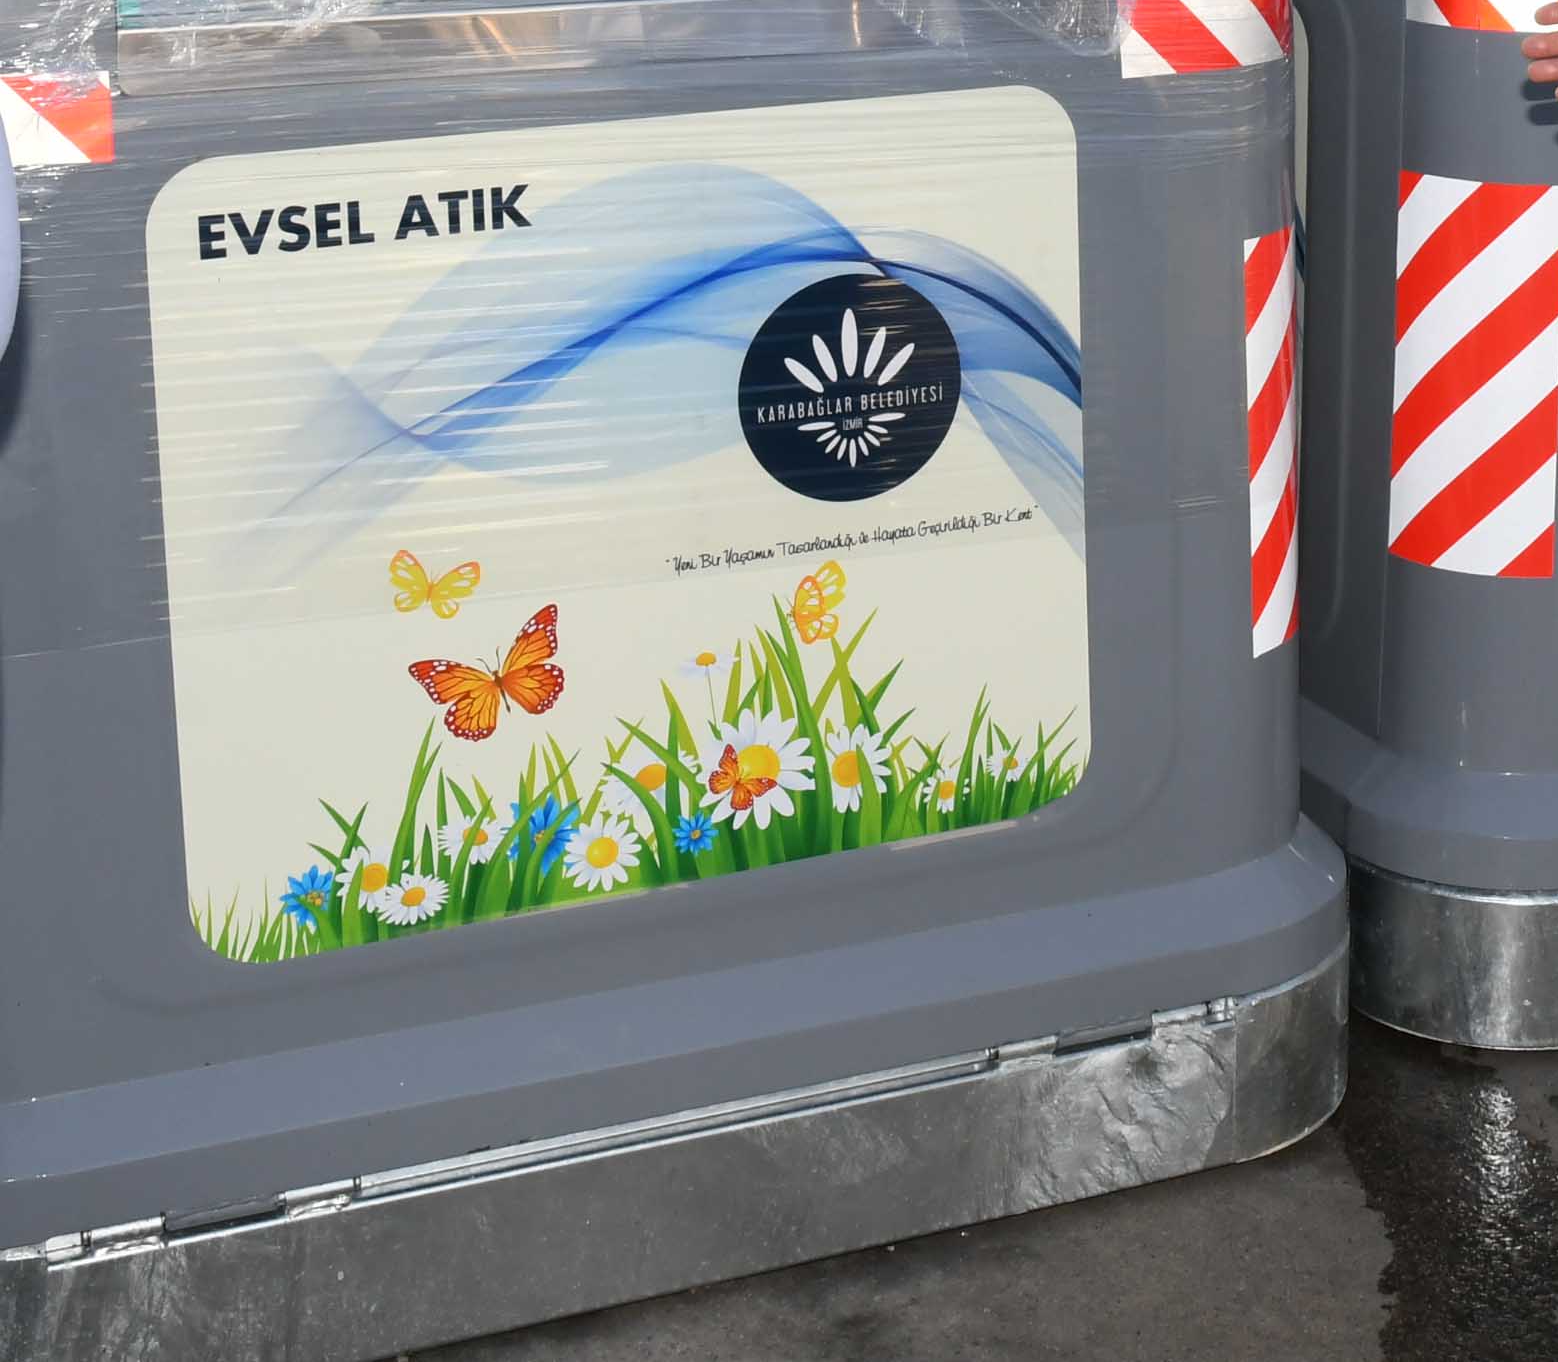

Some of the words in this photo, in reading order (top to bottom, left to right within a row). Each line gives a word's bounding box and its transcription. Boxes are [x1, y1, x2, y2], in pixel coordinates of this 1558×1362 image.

[198, 200, 375, 260] EVSEL
[394, 183, 533, 240] ATIK
[757, 396, 853, 424] KARABAĞLAR
[860, 381, 943, 411] BELEDİYESİ
[698, 553, 722, 569] Bir
[871, 526, 917, 547] Hayata
[982, 511, 1003, 527] Bir
